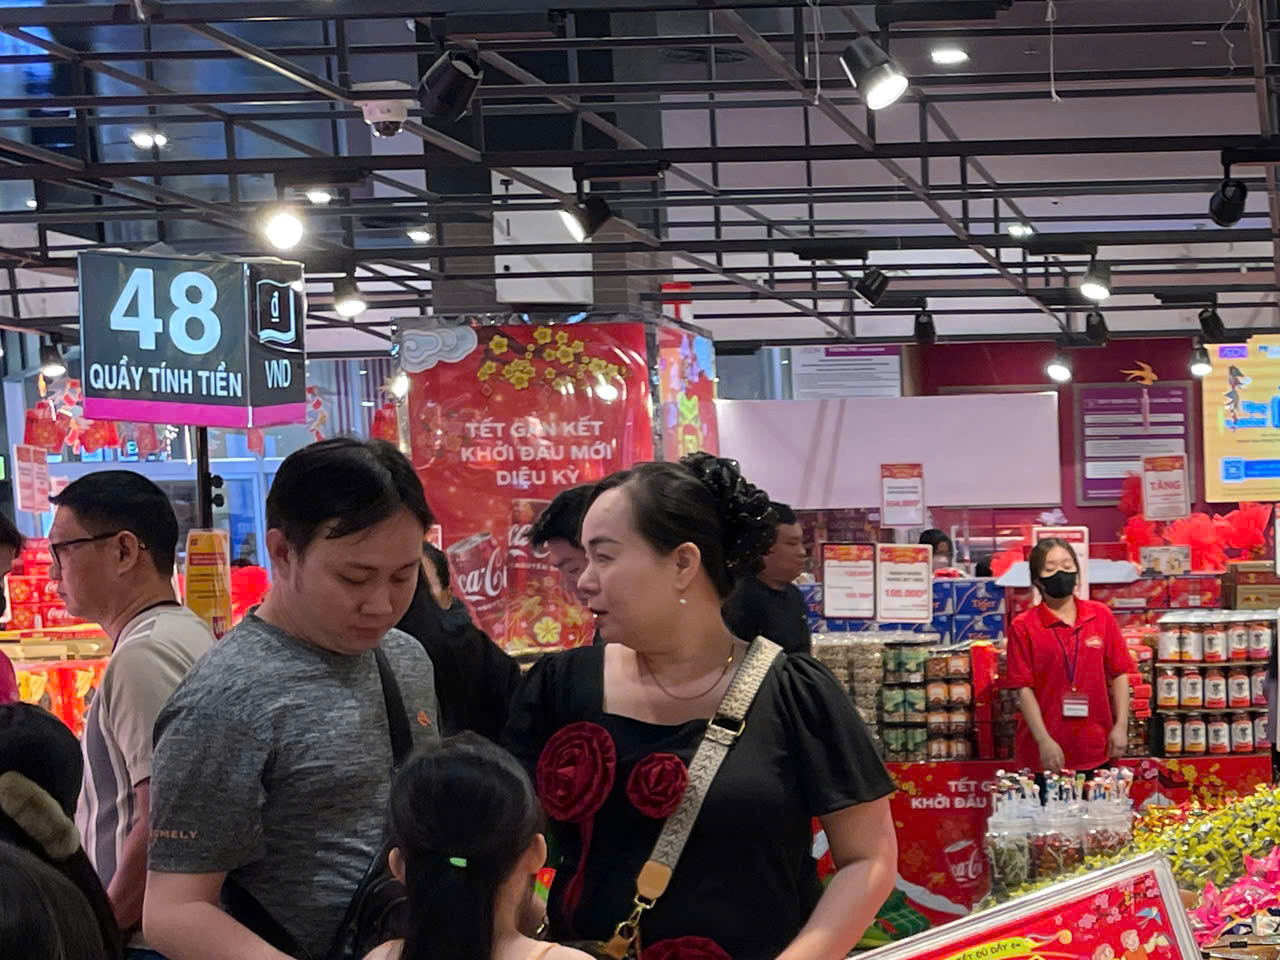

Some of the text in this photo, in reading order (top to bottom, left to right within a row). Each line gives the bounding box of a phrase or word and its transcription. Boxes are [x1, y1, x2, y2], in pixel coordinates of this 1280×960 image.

[110, 267, 222, 355] 48
[89, 355, 243, 398] QUẦY TÍNH TIỀN
[265, 359, 292, 389] VND
[465, 416, 506, 438] TẾT
[563, 415, 604, 437] KẾT
[461, 440, 514, 462] KHỞI
[570, 441, 612, 460] MỚI
